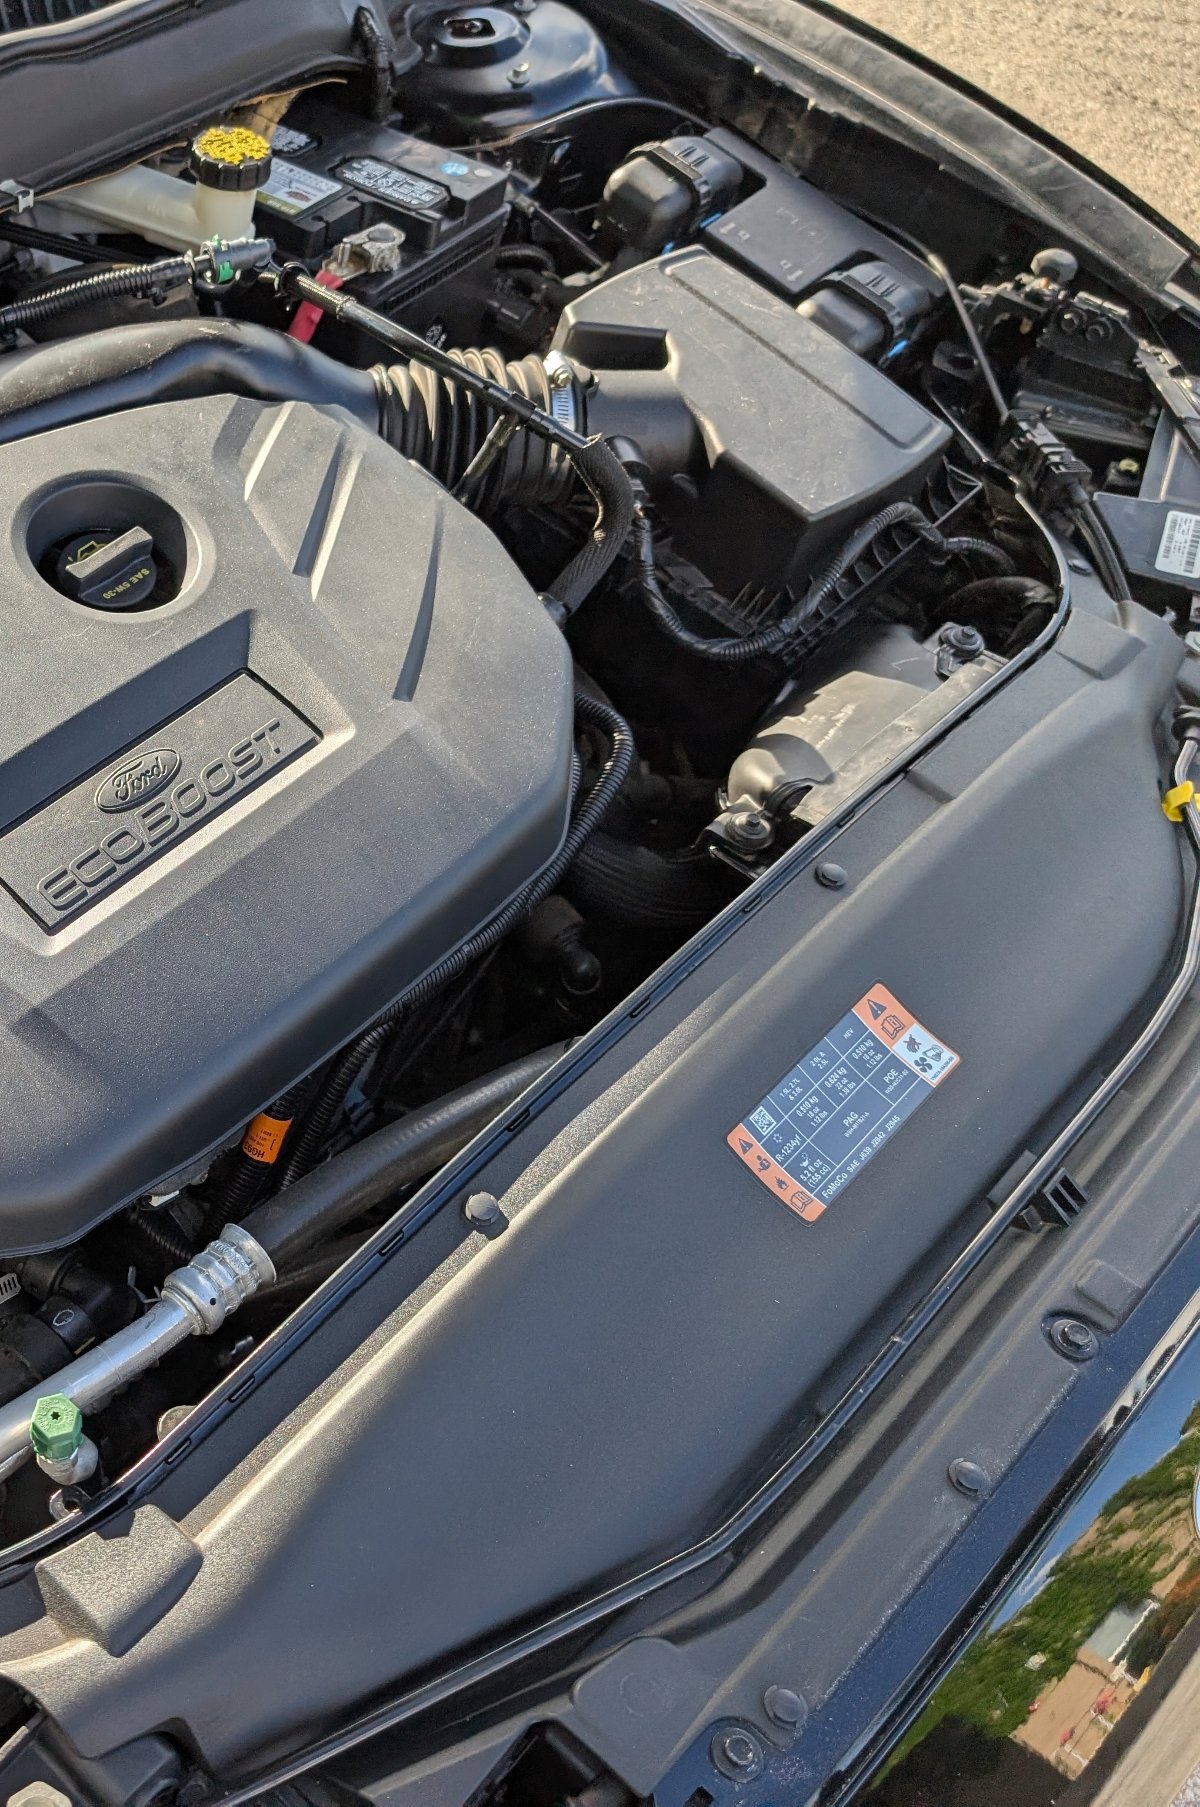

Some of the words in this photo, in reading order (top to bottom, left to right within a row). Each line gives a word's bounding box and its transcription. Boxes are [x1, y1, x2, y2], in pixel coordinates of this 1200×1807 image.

[129, 568, 150, 584] SAE
[102, 582, 131, 599] 5W-30
[111, 755, 168, 801] Ford
[37, 718, 281, 911] ECOBOOST
[843, 1028, 854, 1039] HEV
[852, 1044, 867, 1059] 0.510
[863, 1039, 874, 1047] kg
[874, 1053, 883, 1061] lbs
[836, 1067, 847, 1075] kg
[883, 1068, 898, 1083] POE
[847, 1082, 856, 1090] lbs
[796, 1101, 811, 1117] 0.510
[808, 1096, 819, 1104] kg
[819, 1110, 828, 1118] lbs
[843, 1112, 858, 1127] PAG
[775, 1134, 802, 1162] R-1234yf
[800, 1170, 812, 1181] 5.2
[814, 1159, 822, 1168] oz
[808, 1172, 821, 1188] (155
[820, 1164, 831, 1175] cc)
[822, 1173, 848, 1198] FoMoCo
[847, 1159, 860, 1172] SAE
[859, 1147, 872, 1160] J639
